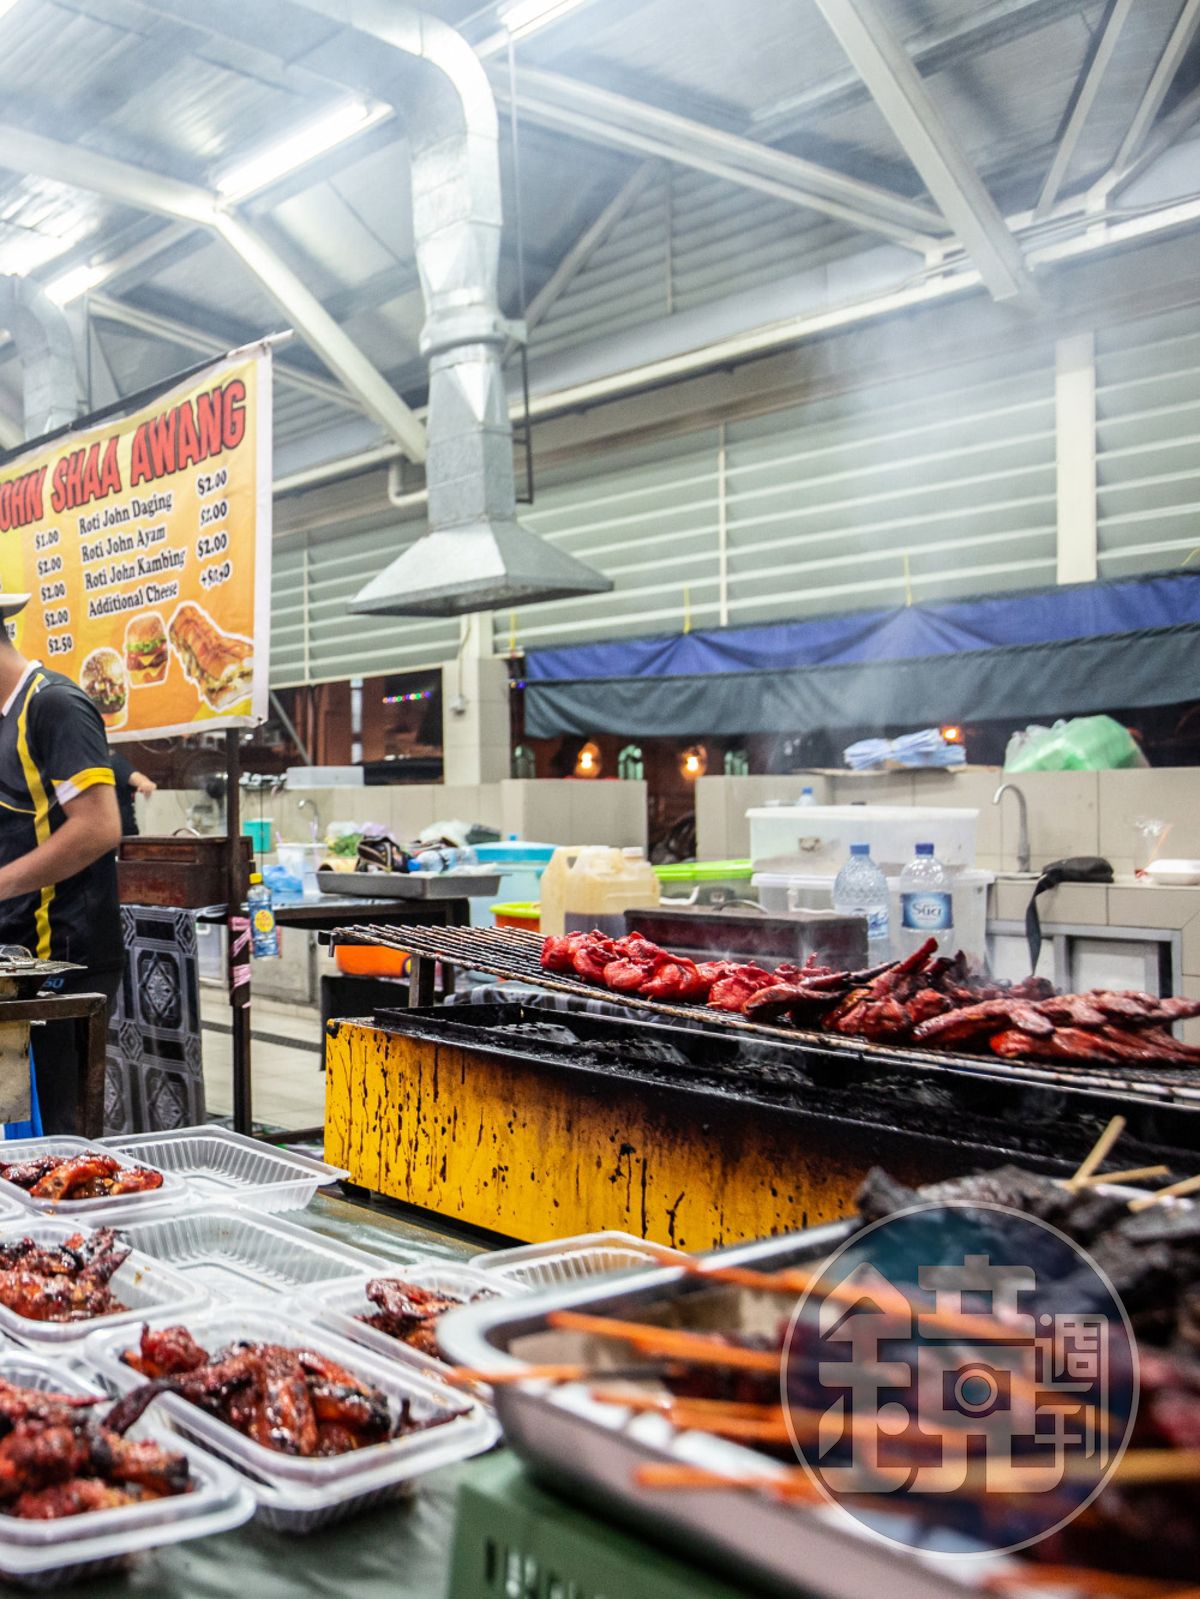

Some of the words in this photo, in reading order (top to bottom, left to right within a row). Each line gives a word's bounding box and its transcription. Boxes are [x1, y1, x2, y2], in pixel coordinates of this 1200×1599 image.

[51, 434, 123, 513] SHAA
[130, 379, 246, 487] AWANG
[79, 513, 100, 535] Roti
[103, 508, 130, 527] John
[132, 493, 172, 518] Daging
[197, 469, 227, 496] $2.00
[36, 530, 59, 549] $1.00
[81, 541, 104, 562] Roti
[106, 536, 134, 555] John
[137, 526, 165, 548] Ayam
[38, 556, 61, 576] $2.00
[85, 568, 107, 590] Roti
[110, 564, 135, 583] John
[137, 549, 186, 576] Kambing
[197, 532, 227, 558] $2.00
[41, 583, 65, 602] $2.00
[89, 588, 144, 617] Additional
[146, 582, 178, 603] Cheese
[44, 609, 68, 628] $2.00
[48, 635, 72, 653] $2.50
